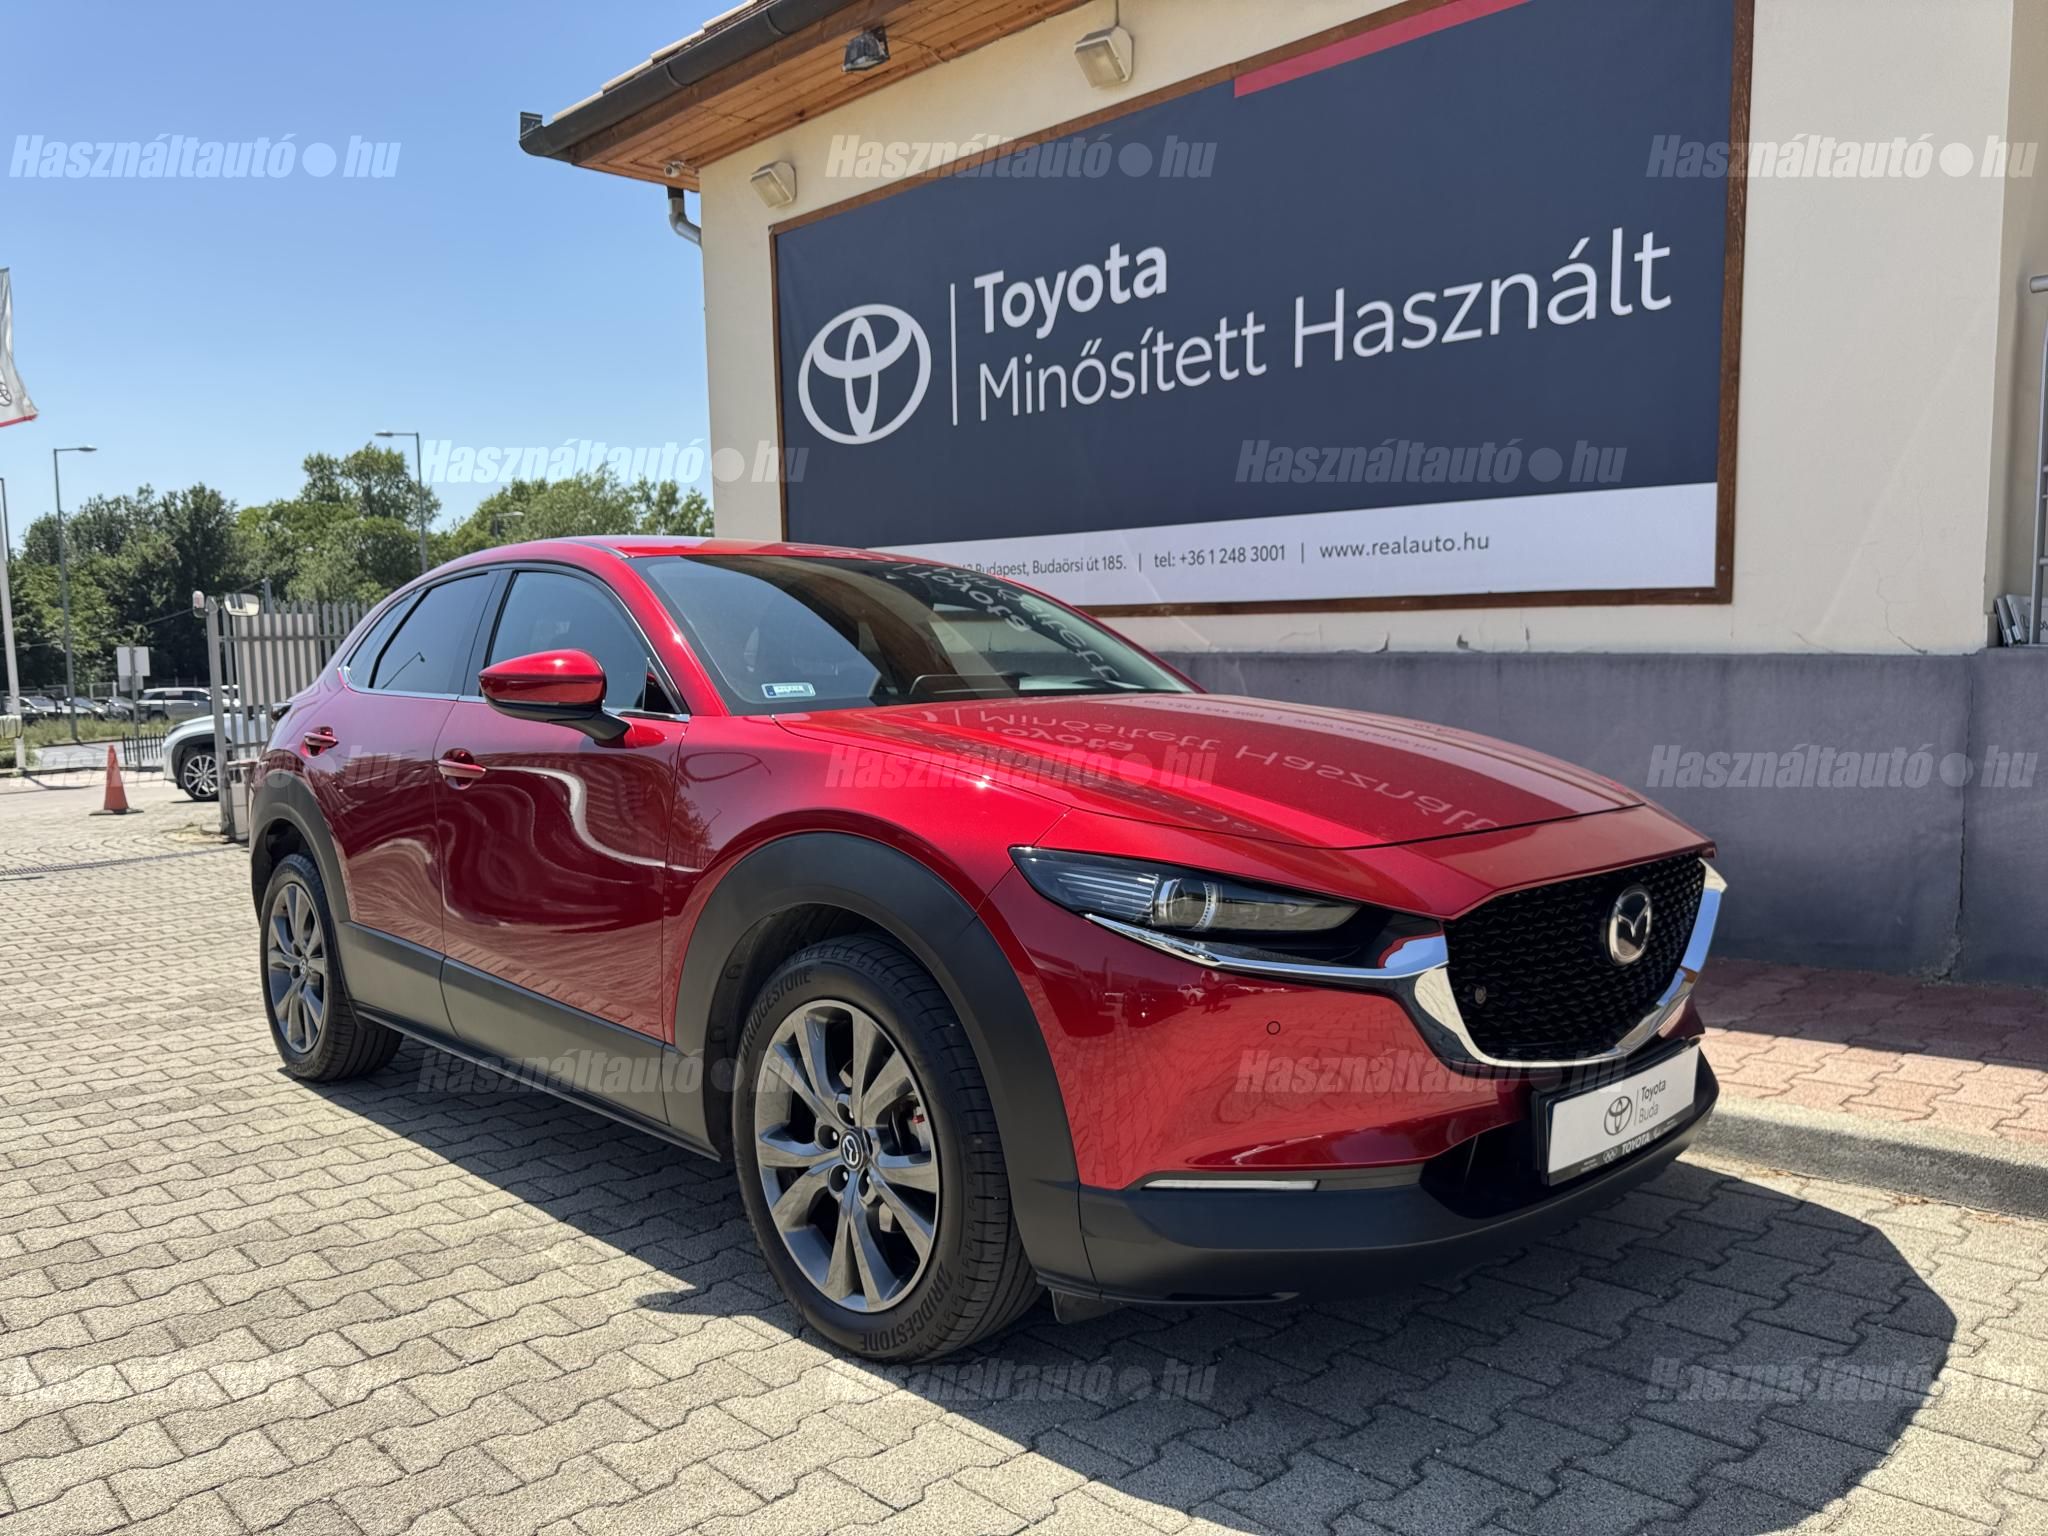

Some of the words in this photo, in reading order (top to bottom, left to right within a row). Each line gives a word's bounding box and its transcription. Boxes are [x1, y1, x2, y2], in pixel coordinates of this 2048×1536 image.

[974, 243, 1168, 339] Toyota
[980, 311, 1268, 422] Minősített
[1294, 227, 1672, 369] Használt
[1033, 558, 1083, 574] Budaörsi
[1087, 557, 1099, 572] út
[1102, 555, 1127, 571] 185.
[1154, 553, 1176, 568] tel:
[1179, 552, 1206, 566] +36
[1218, 546, 1247, 563] 248
[1250, 544, 1286, 562] 3001
[1319, 532, 1490, 559] www.realauto.hu
[1641, 1079, 1667, 1102] Toyota
[1622, 1132, 1651, 1155] TOYOTA
